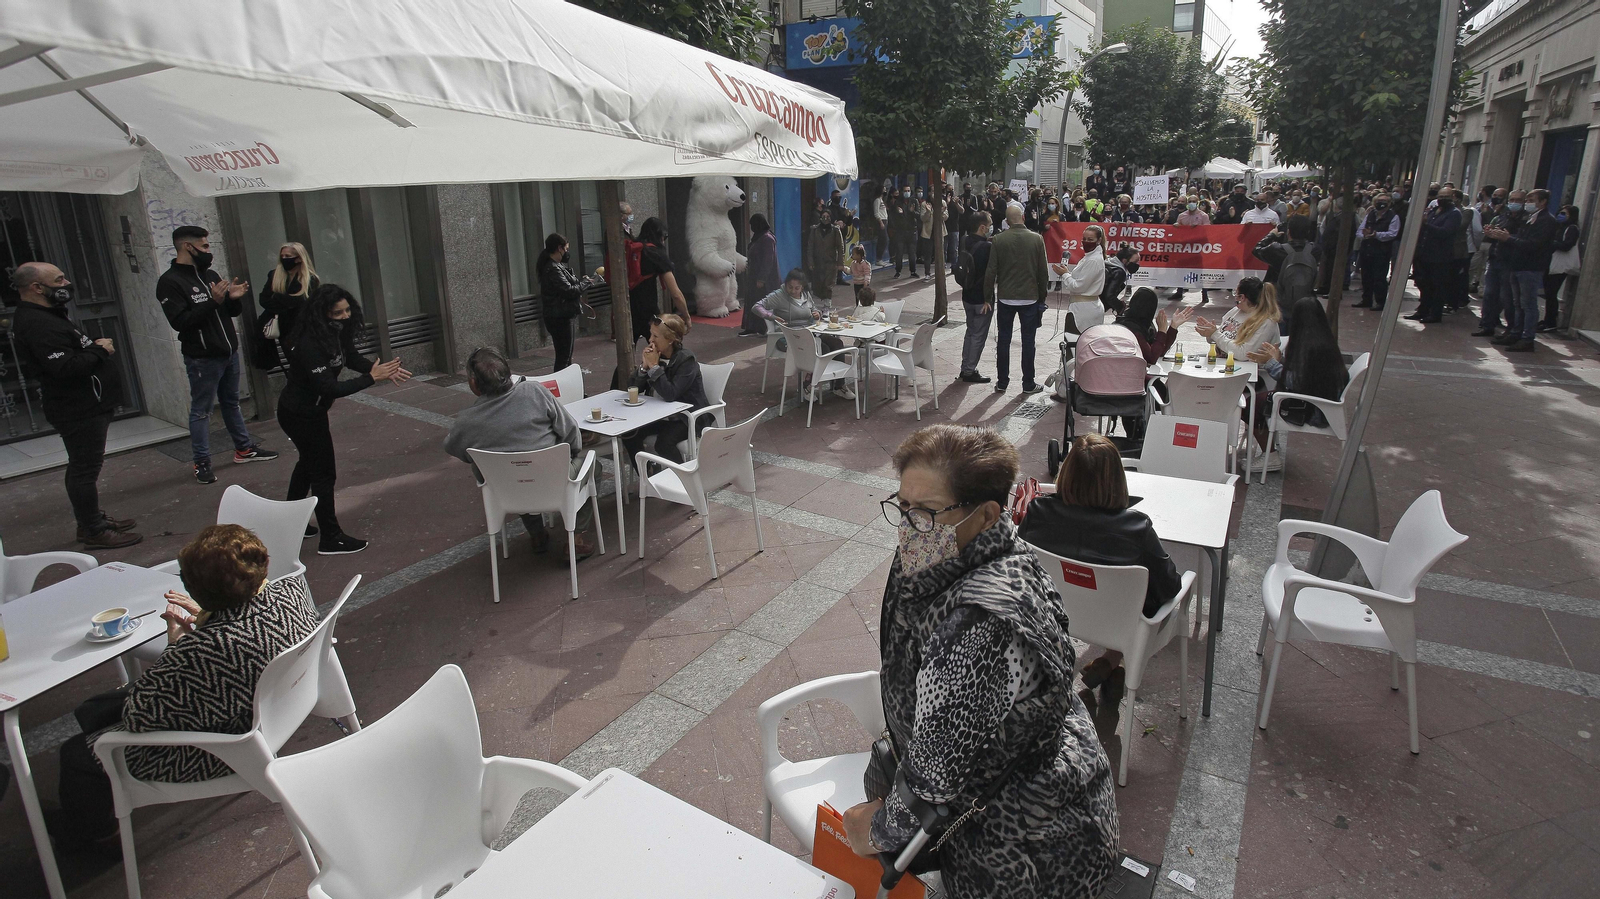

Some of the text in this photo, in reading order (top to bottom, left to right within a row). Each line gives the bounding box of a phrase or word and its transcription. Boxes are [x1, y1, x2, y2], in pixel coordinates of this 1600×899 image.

[805, 34, 828, 49] TOY
[803, 49, 822, 57] PLAN
[705, 61, 831, 147] Cruzcampo
[754, 131, 835, 168] ESPECIAL
[1108, 226, 1118, 237] 8
[1120, 226, 1165, 239] MESES
[1062, 239, 1078, 250] 32
[1147, 242, 1222, 254] CERRADOS
